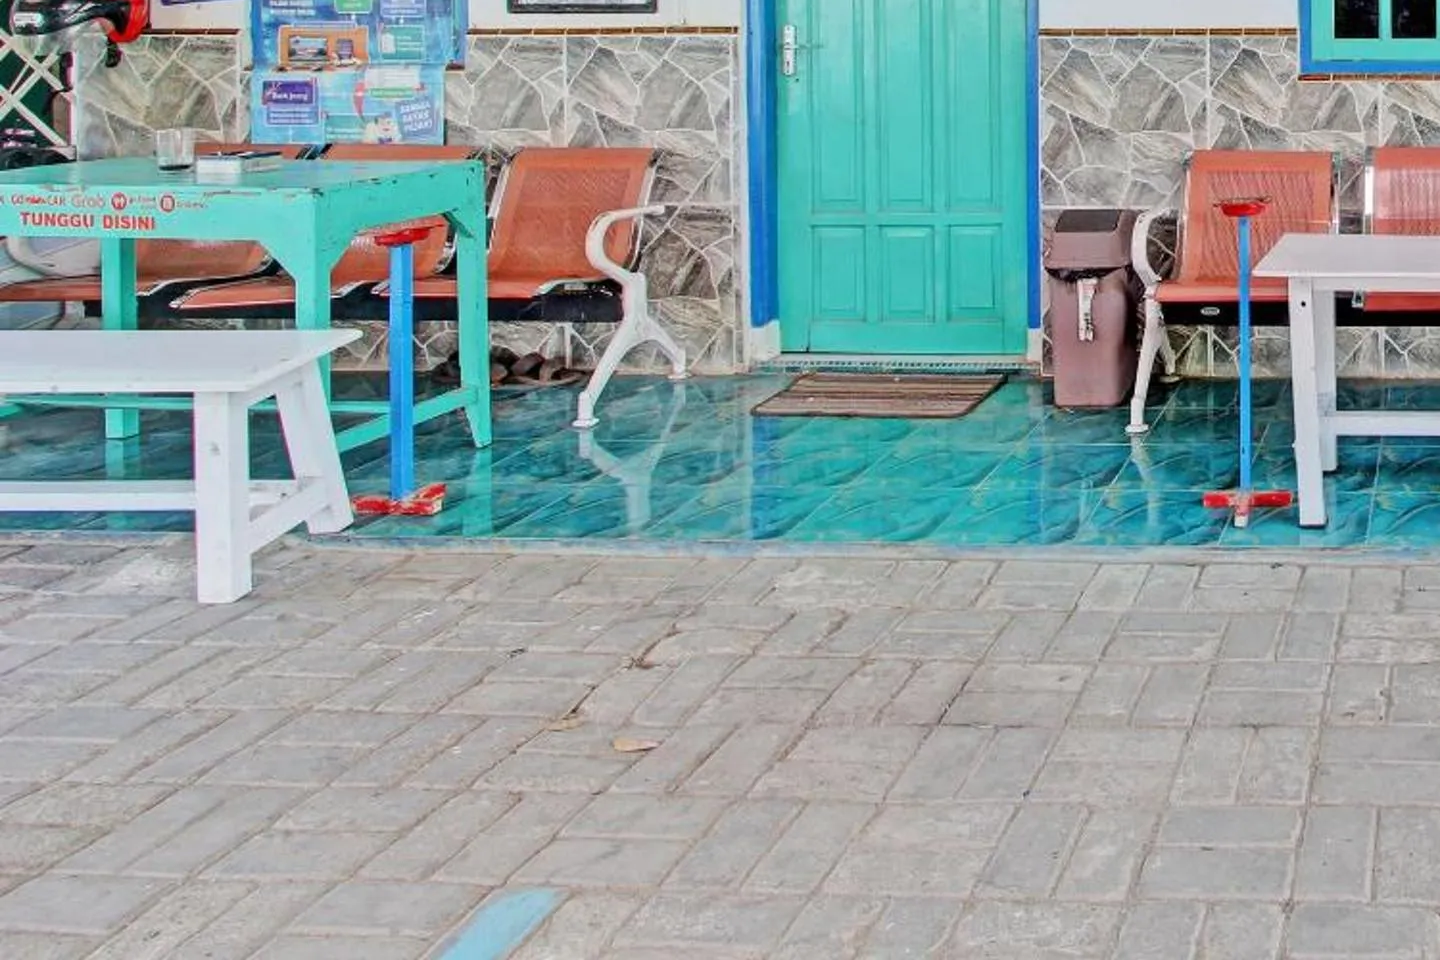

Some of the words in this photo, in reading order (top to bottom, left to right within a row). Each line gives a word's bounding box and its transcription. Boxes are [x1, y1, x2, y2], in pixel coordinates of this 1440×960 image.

[71, 193, 106, 207] Grab
[20, 212, 95, 228] TUNGGU
[103, 214, 155, 230] DISINI
